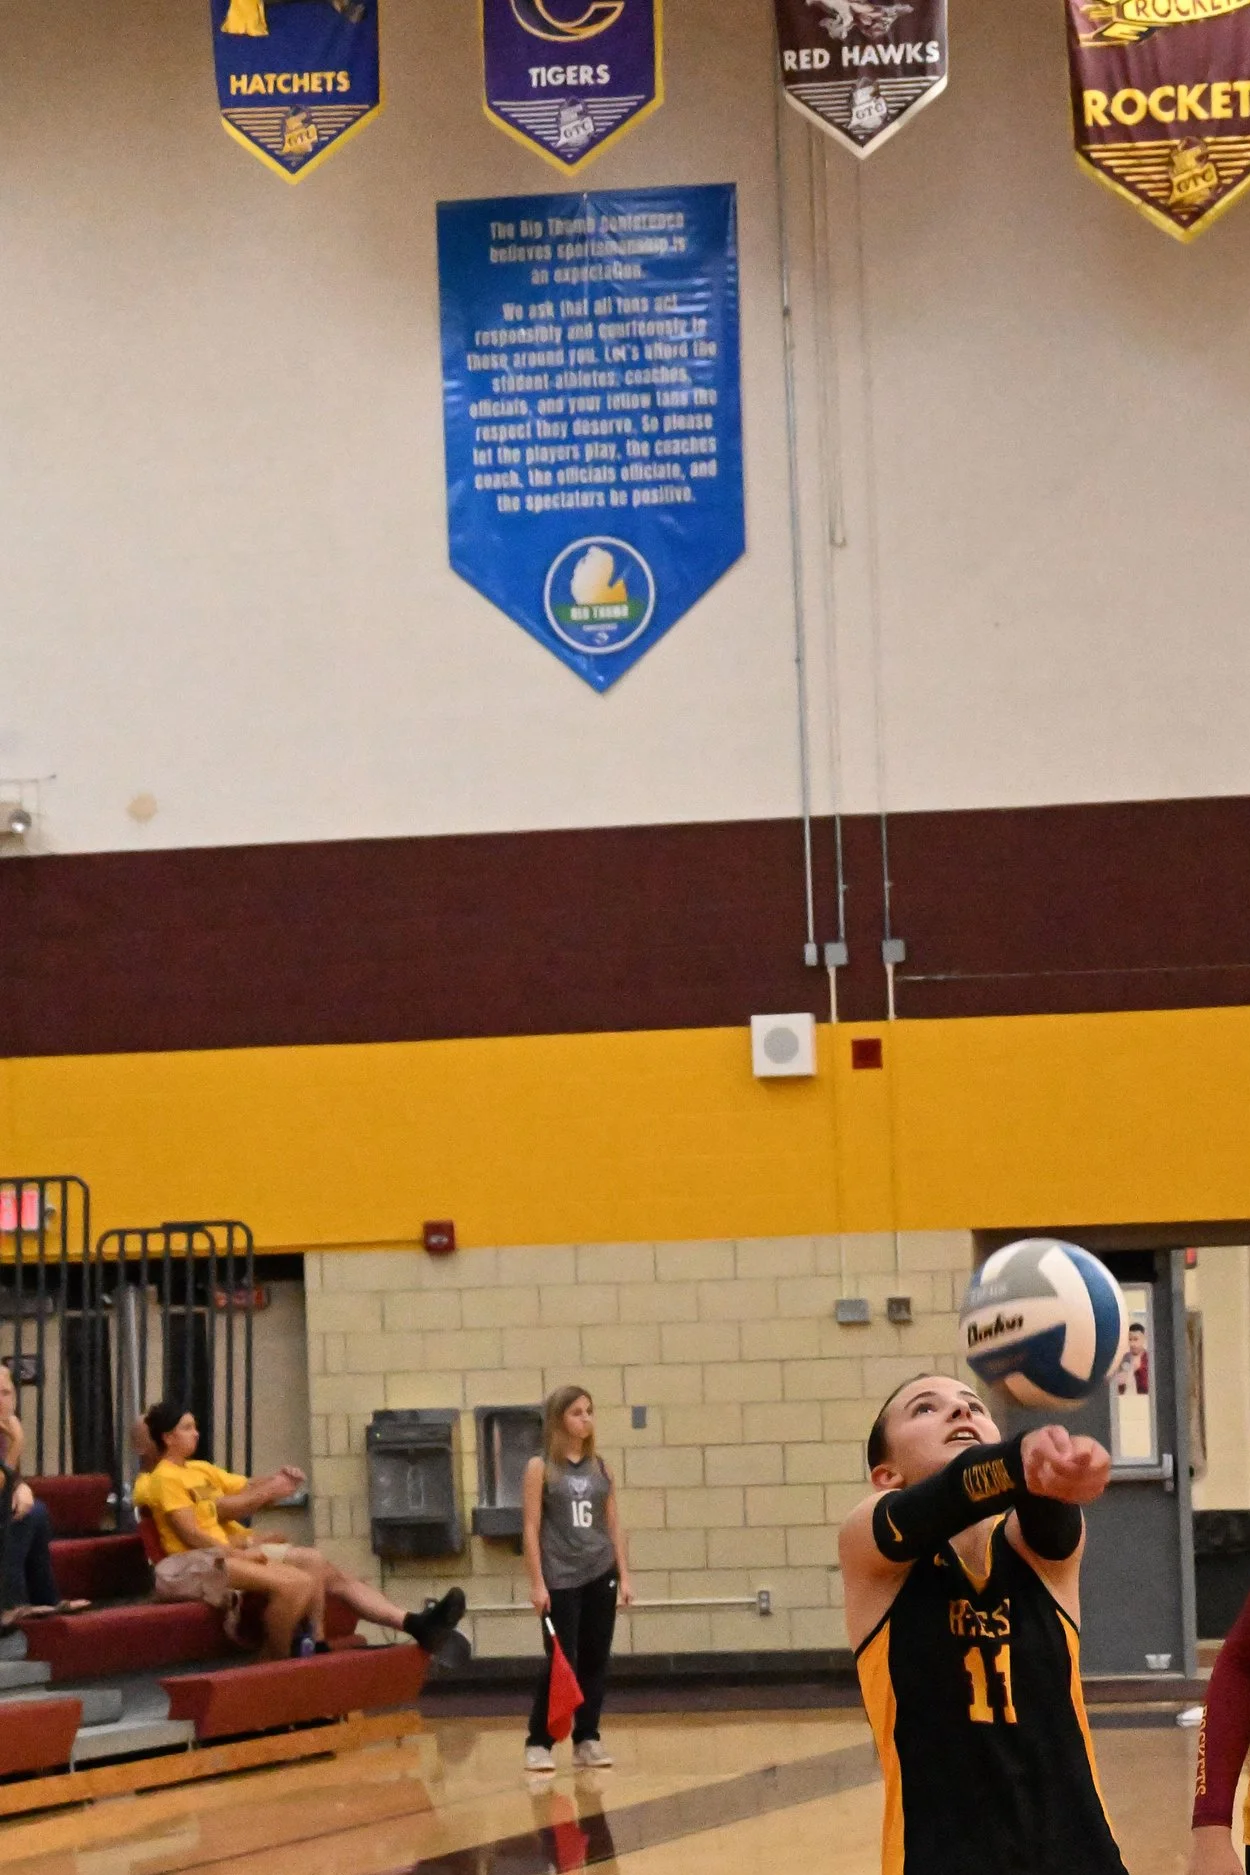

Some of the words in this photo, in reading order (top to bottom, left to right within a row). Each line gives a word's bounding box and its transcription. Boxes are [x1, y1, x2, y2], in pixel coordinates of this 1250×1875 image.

[783, 48, 831, 71] RED
[841, 40, 940, 67] HAWKS
[230, 71, 350, 95] HATCHETS
[528, 64, 611, 88] TIGERS
[571, 1500, 593, 1528] 16
[963, 1644, 1018, 1724] 11
